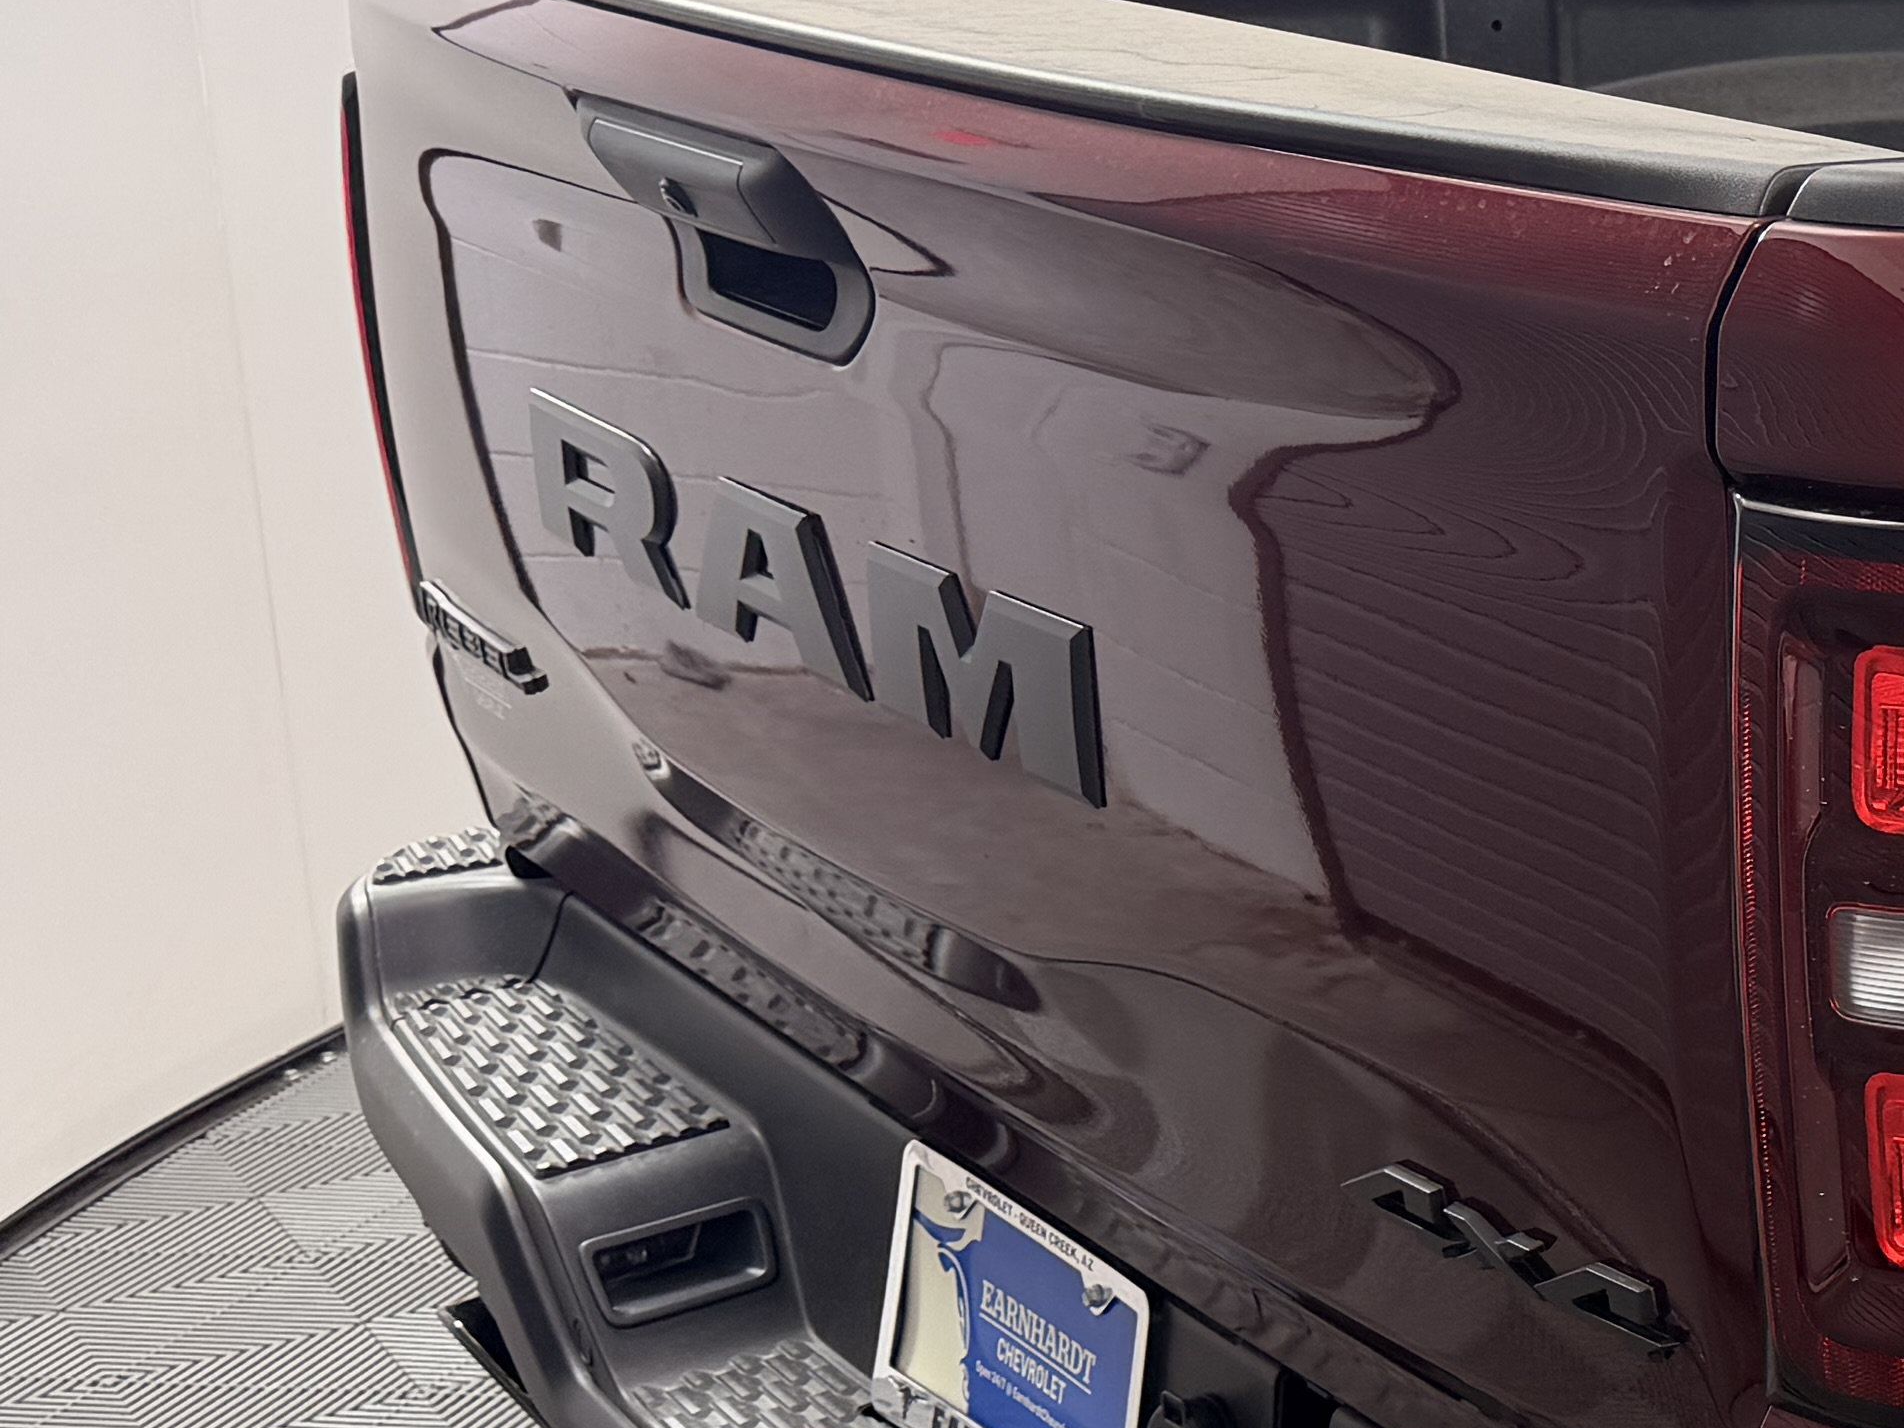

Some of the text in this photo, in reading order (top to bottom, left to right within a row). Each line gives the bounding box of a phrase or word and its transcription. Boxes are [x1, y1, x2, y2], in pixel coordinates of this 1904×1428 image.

[529, 388, 1106, 810] RAM
[966, 1176, 1013, 1216] CHEVROLET
[1018, 1212, 1047, 1241] QUEEN
[981, 1279, 1098, 1385] EARNHARDT
[997, 1337, 1067, 1405] CHEVROLET
